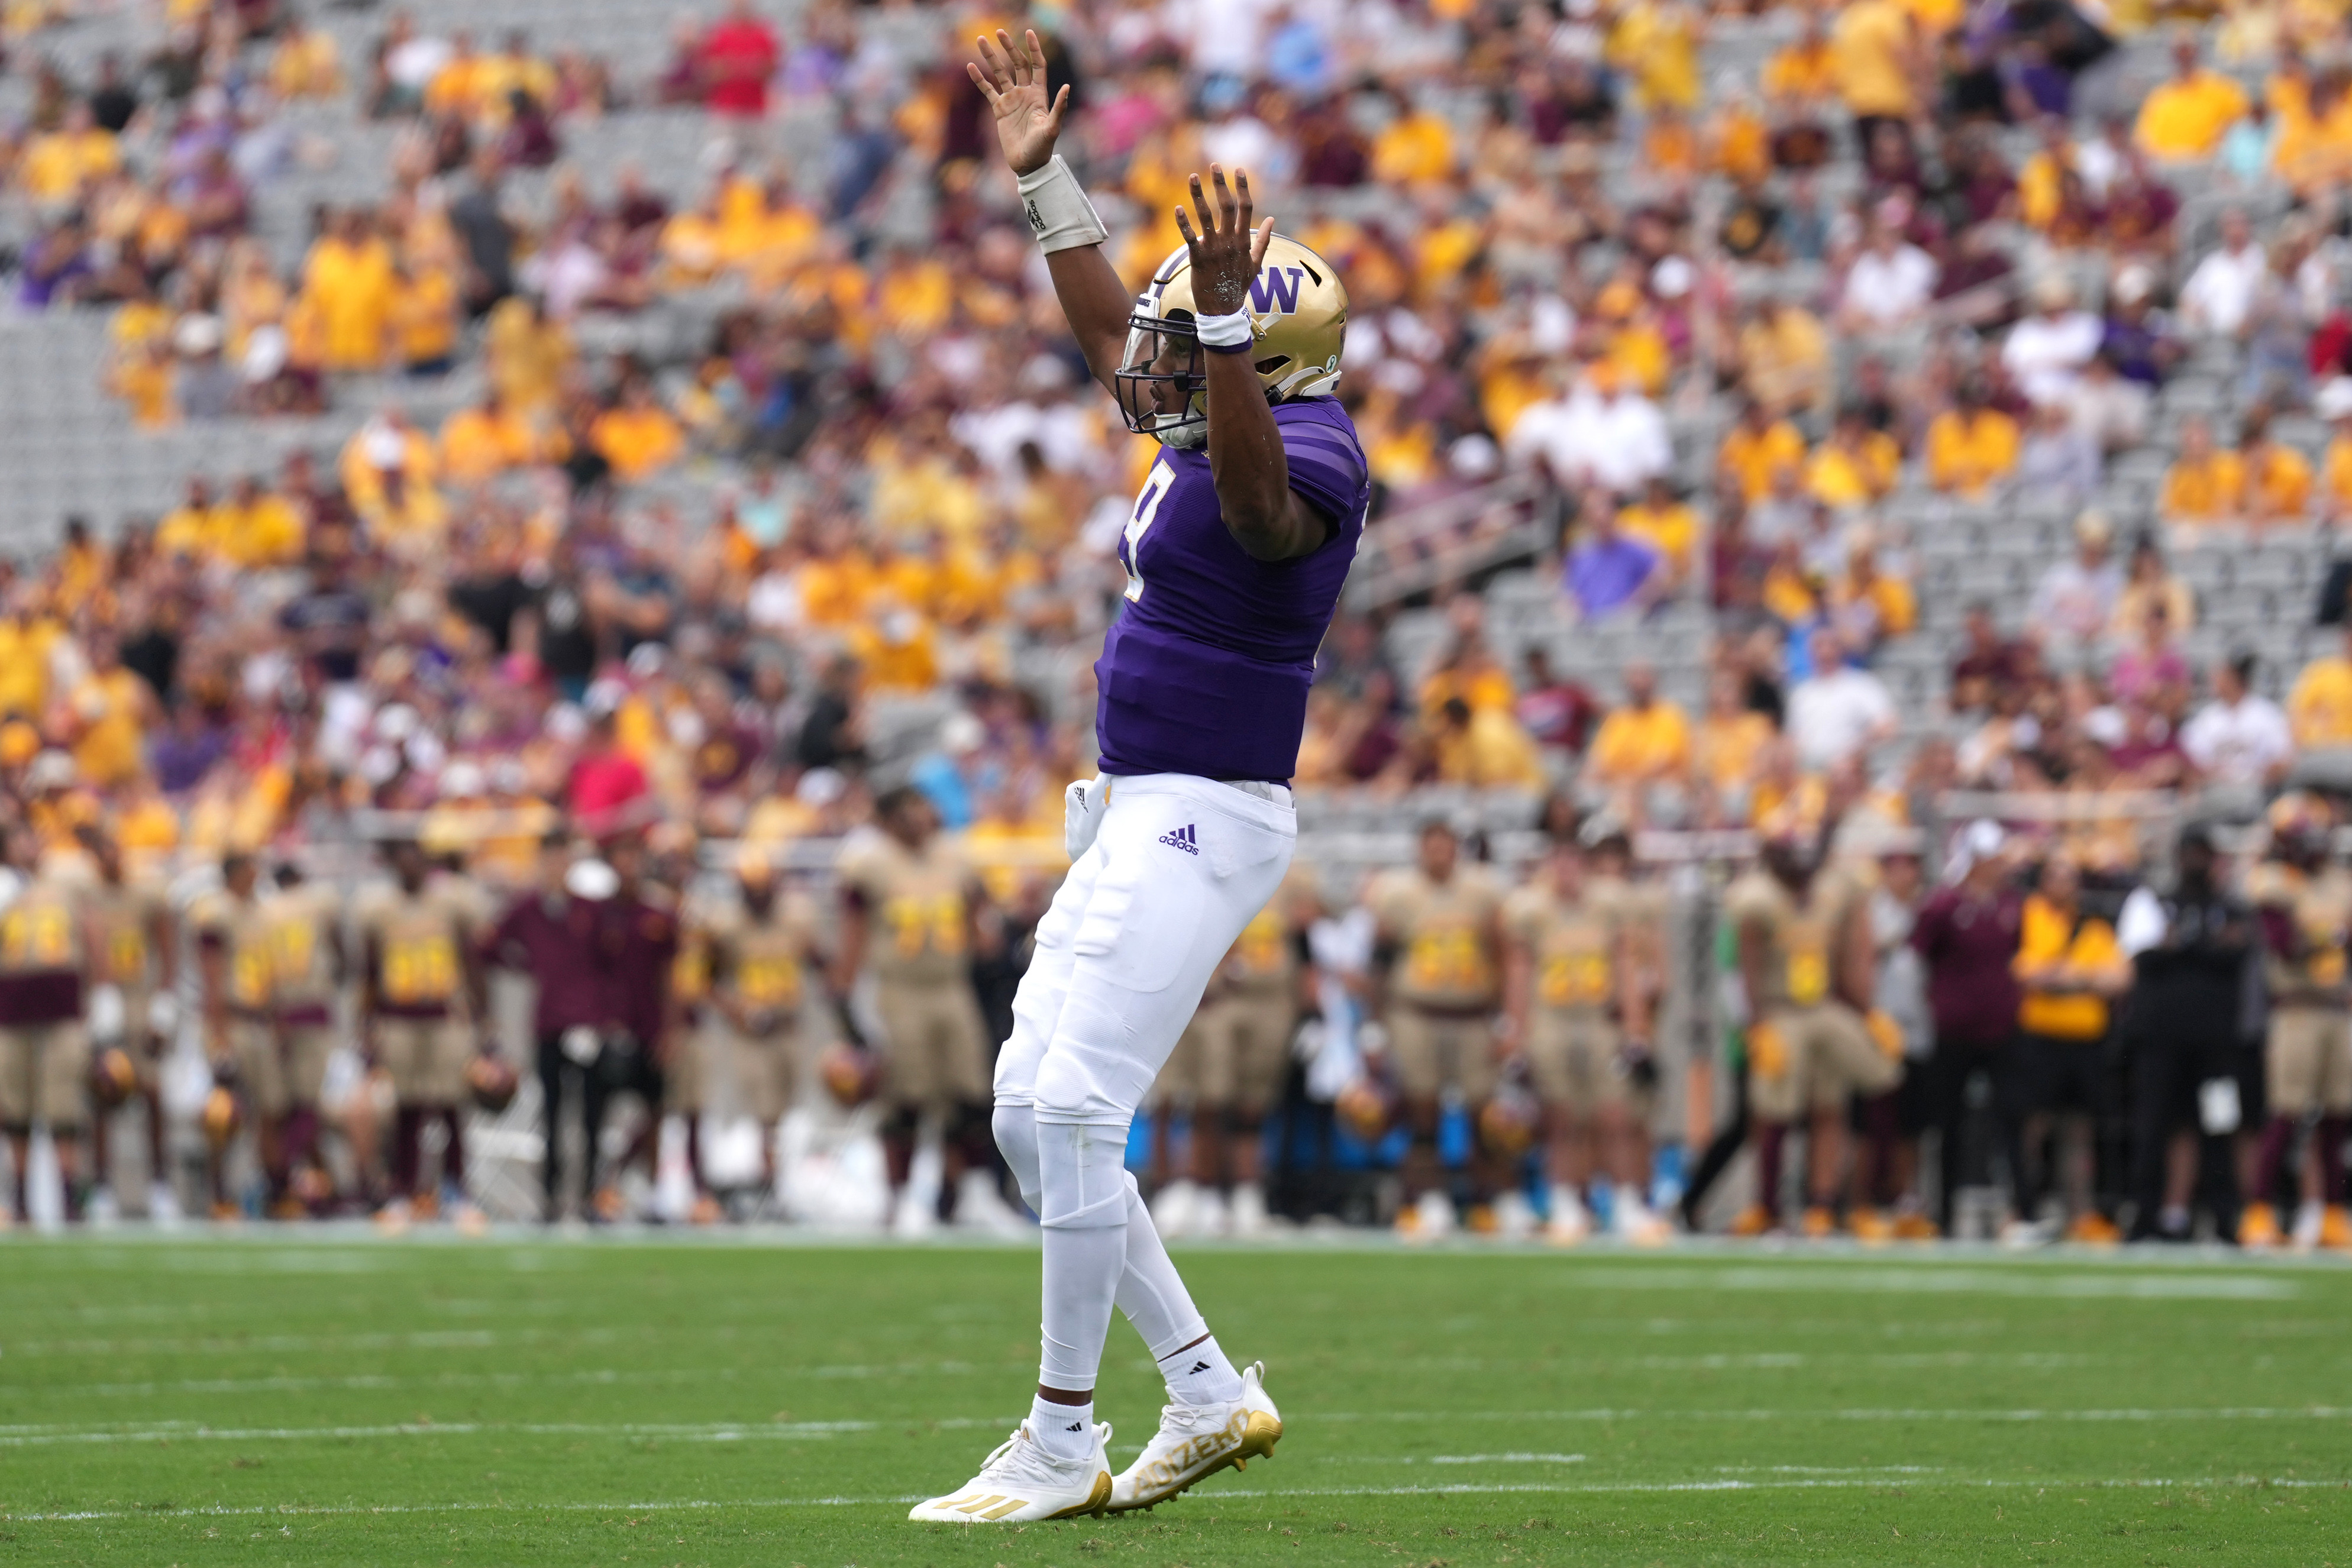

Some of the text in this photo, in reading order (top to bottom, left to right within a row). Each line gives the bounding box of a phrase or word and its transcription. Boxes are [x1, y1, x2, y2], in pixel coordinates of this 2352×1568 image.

[1029, 199, 1046, 229] adidas
[1249, 265, 1305, 315] W
[1119, 458, 1177, 603] 9
[1159, 835, 1199, 855] adidas
